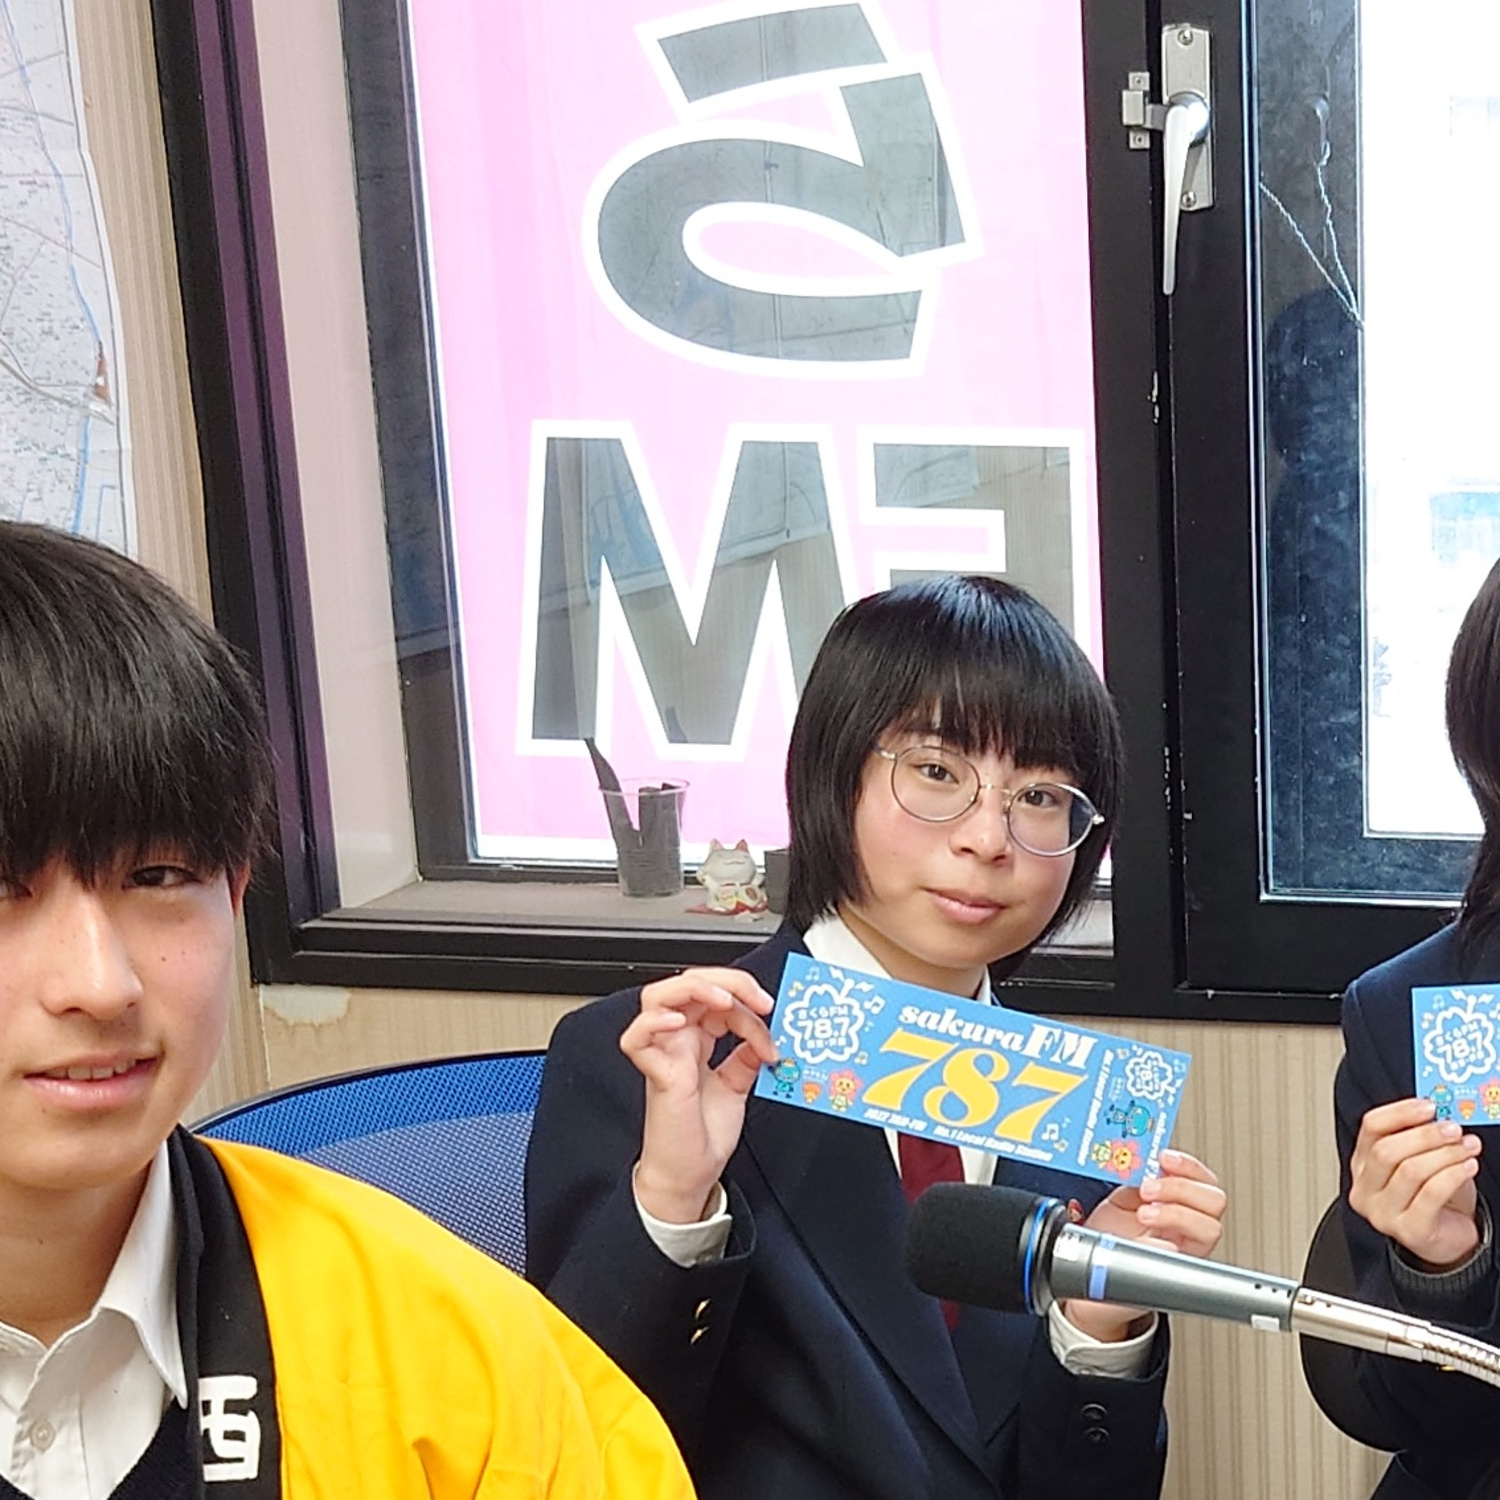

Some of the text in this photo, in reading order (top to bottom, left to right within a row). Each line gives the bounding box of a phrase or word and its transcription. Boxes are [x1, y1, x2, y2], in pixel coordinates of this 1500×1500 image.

[797, 1017, 849, 1039] 78.7
[898, 1004, 1098, 1069] sakuraFM
[1438, 1031, 1481, 1062] 78.7
[861, 1026, 1089, 1142] 787
